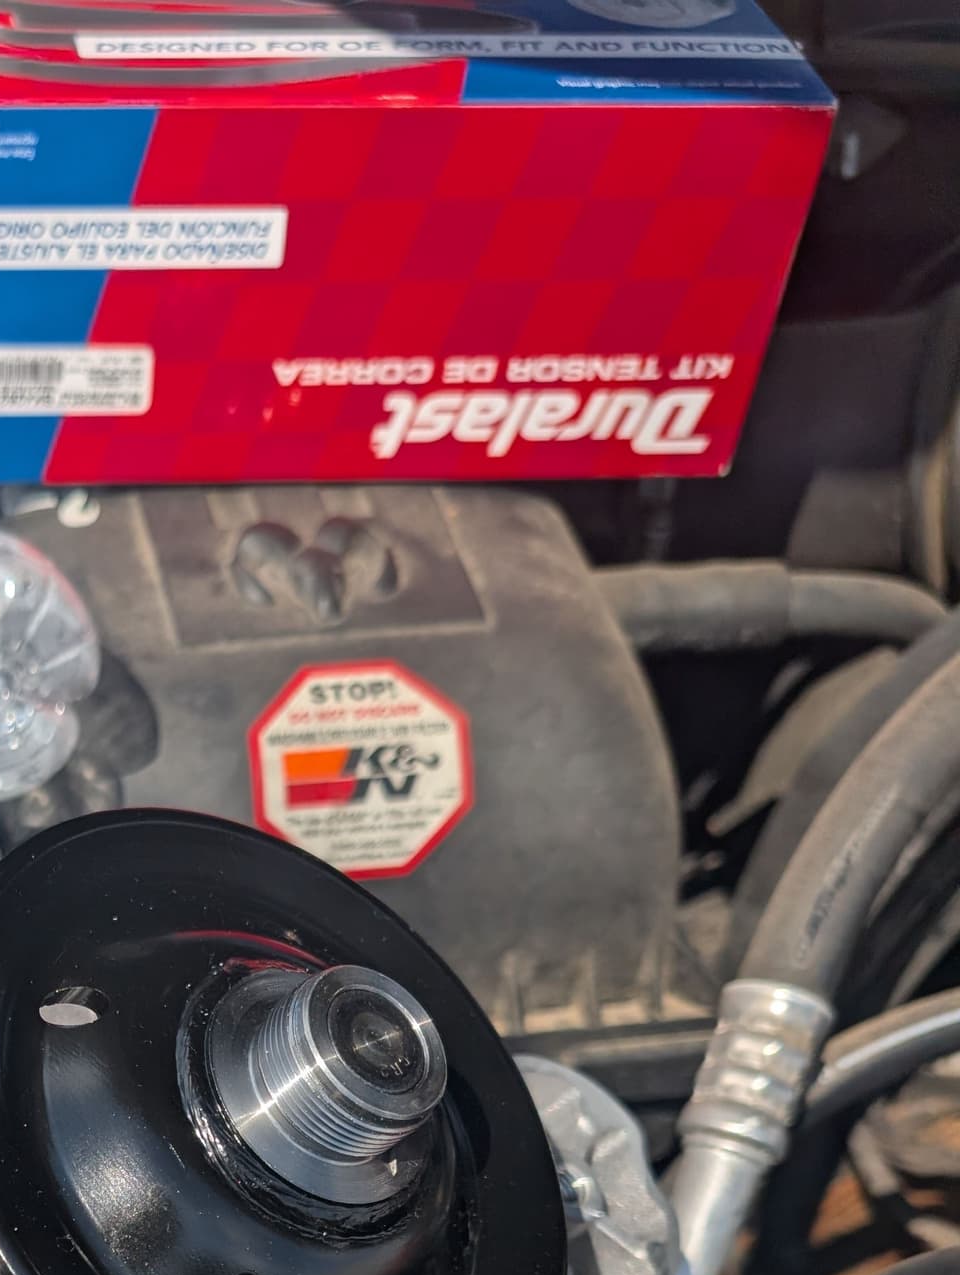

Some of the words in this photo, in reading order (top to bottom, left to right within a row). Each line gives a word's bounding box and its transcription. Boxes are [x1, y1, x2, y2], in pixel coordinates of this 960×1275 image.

[95, 41, 255, 54] DESIGNED
[266, 41, 328, 52] FOR
[336, 40, 383, 52] OE
[502, 40, 543, 51] FIT
[554, 40, 622, 52] AND
[631, 40, 791, 53] FUNCTION
[52, 221, 130, 240] EQUIPO
[141, 221, 171, 239] DEL
[178, 220, 272, 242] FUNCIÓN
[82, 241, 99, 260] EL
[116, 241, 155, 260] PARA
[167, 240, 269, 264] DISEÑADO
[272, 357, 434, 386] CORREA
[443, 356, 499, 384] DE
[507, 355, 663, 383] TENSOR
[668, 354, 735, 380] KIT
[369, 386, 715, 459] Duralast
[309, 681, 397, 704] STOP!
